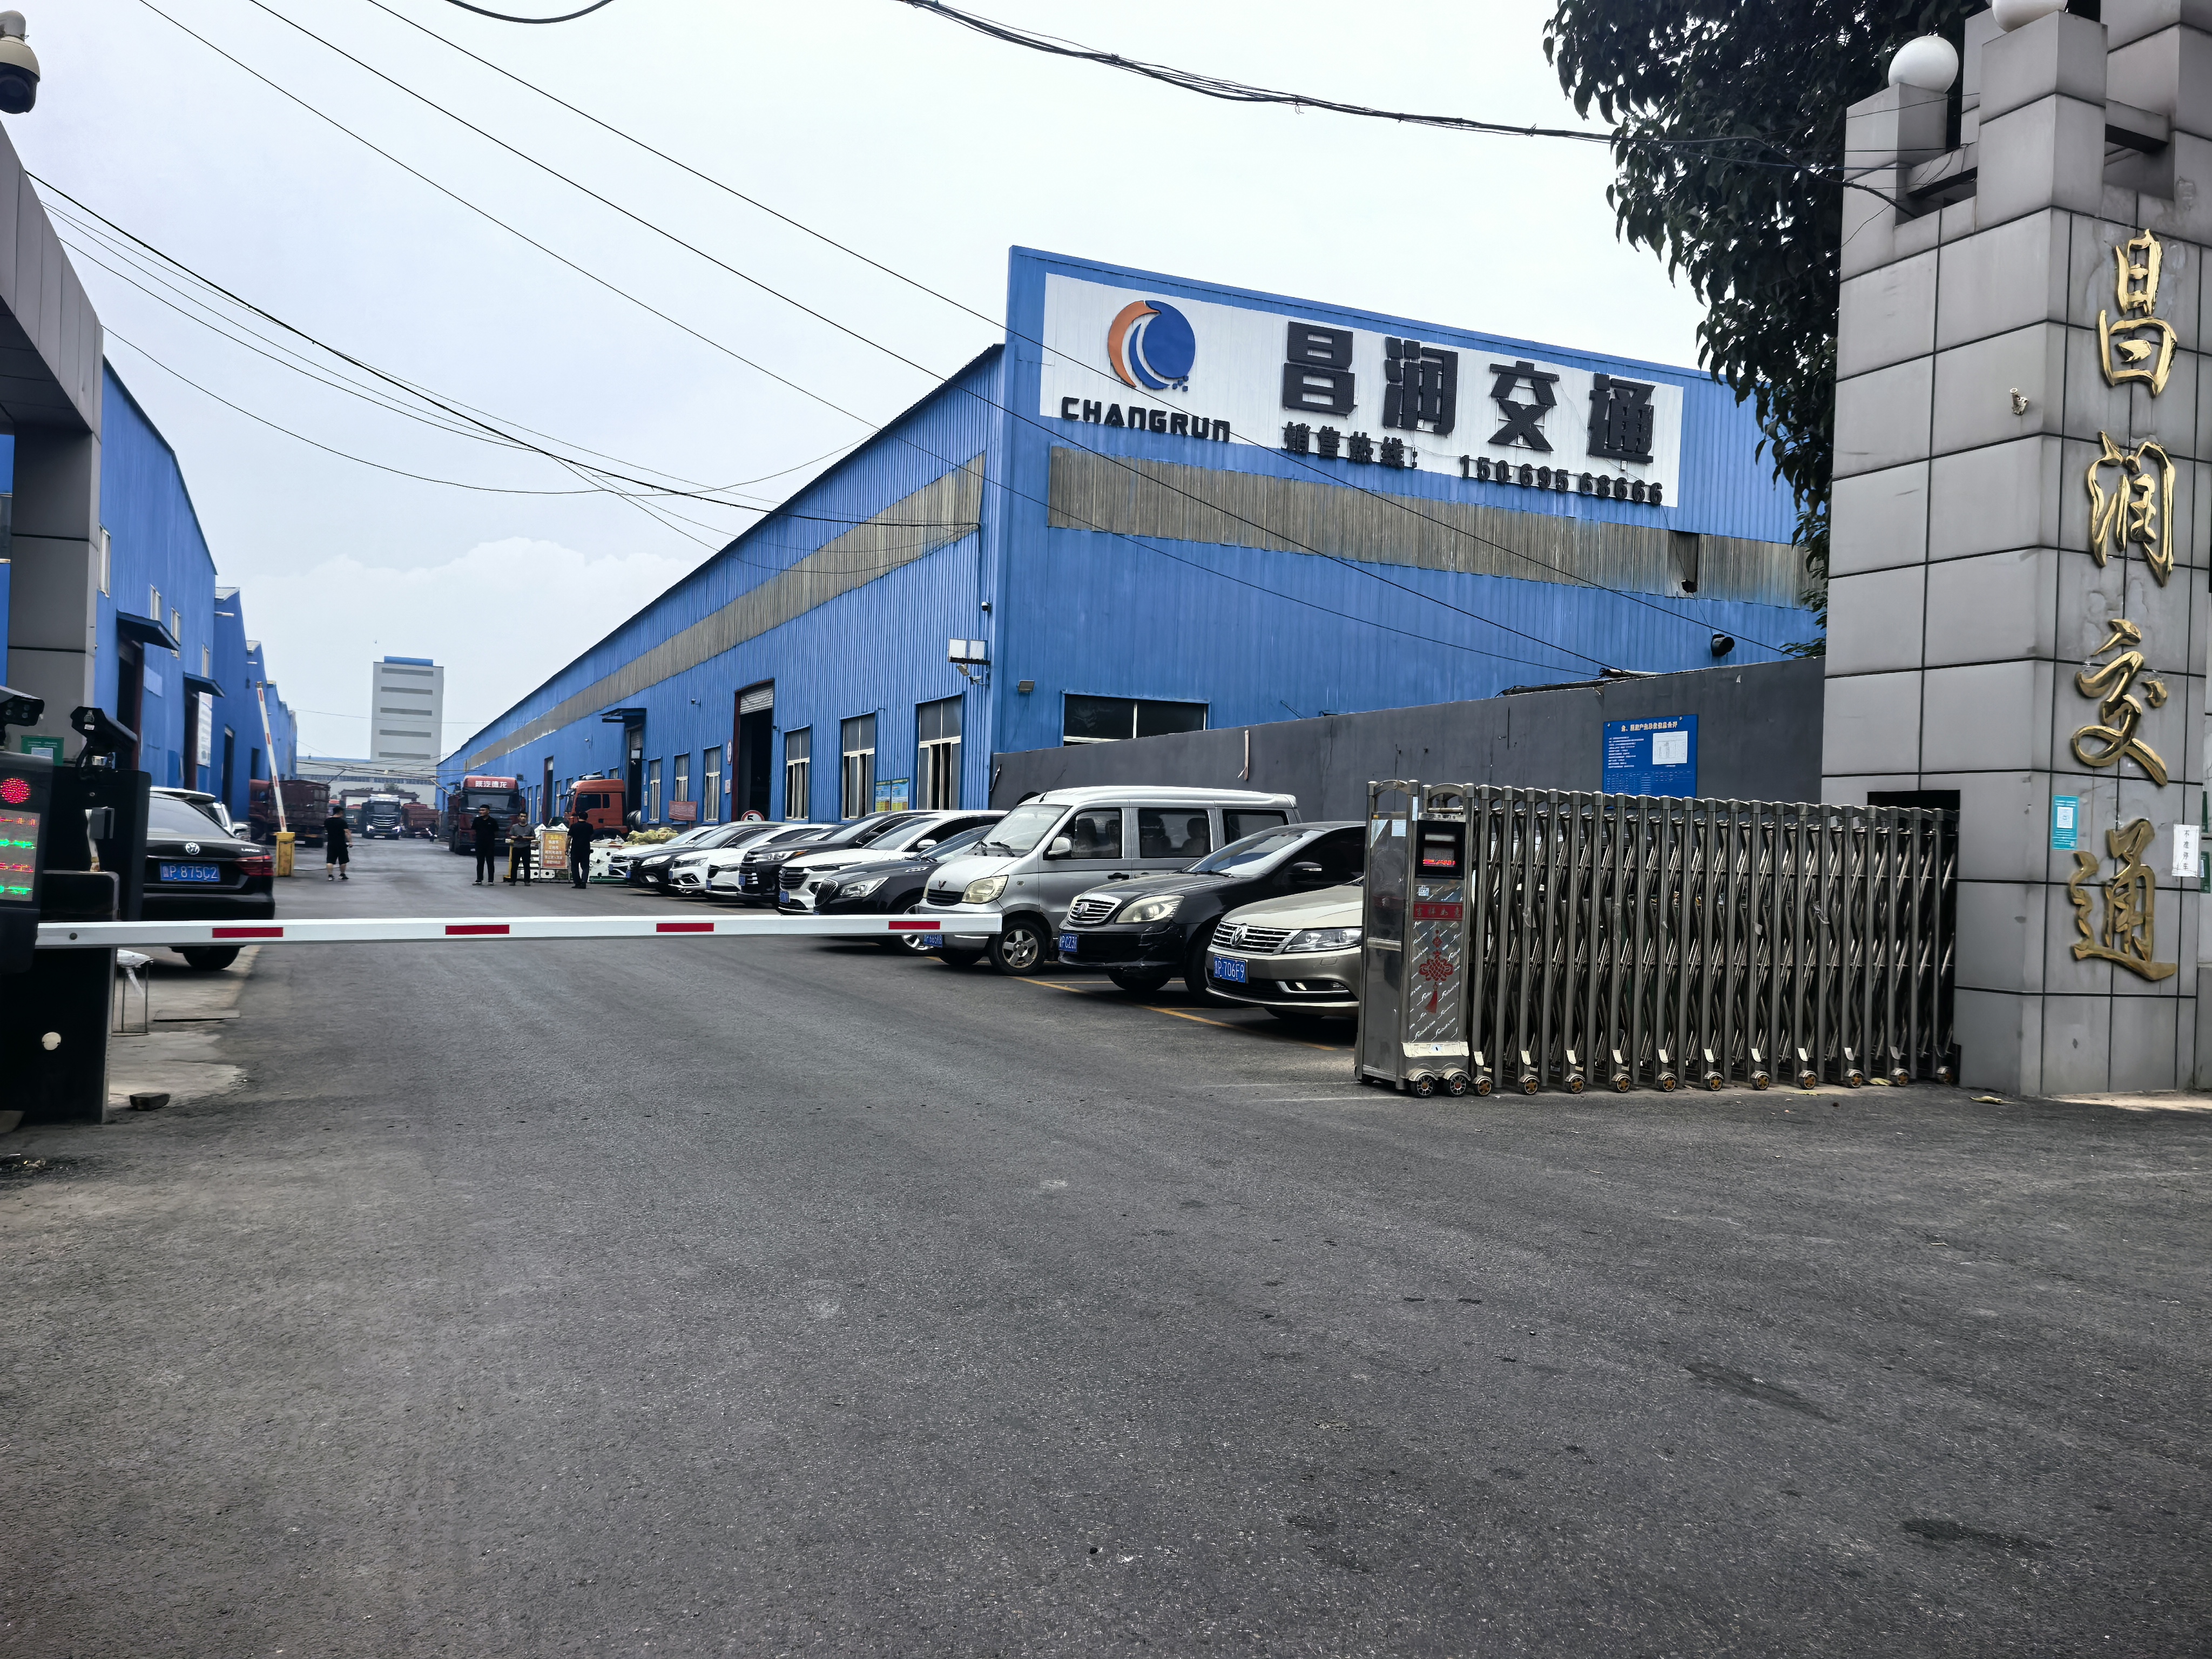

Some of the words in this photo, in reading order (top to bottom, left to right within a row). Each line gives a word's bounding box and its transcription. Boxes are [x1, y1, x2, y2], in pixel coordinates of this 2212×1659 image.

[1283, 320, 1656, 464] 昌润交通
[1061, 396, 1230, 442] CHANGRUN
[1416, 906, 1461, 918] 吉祥如意
